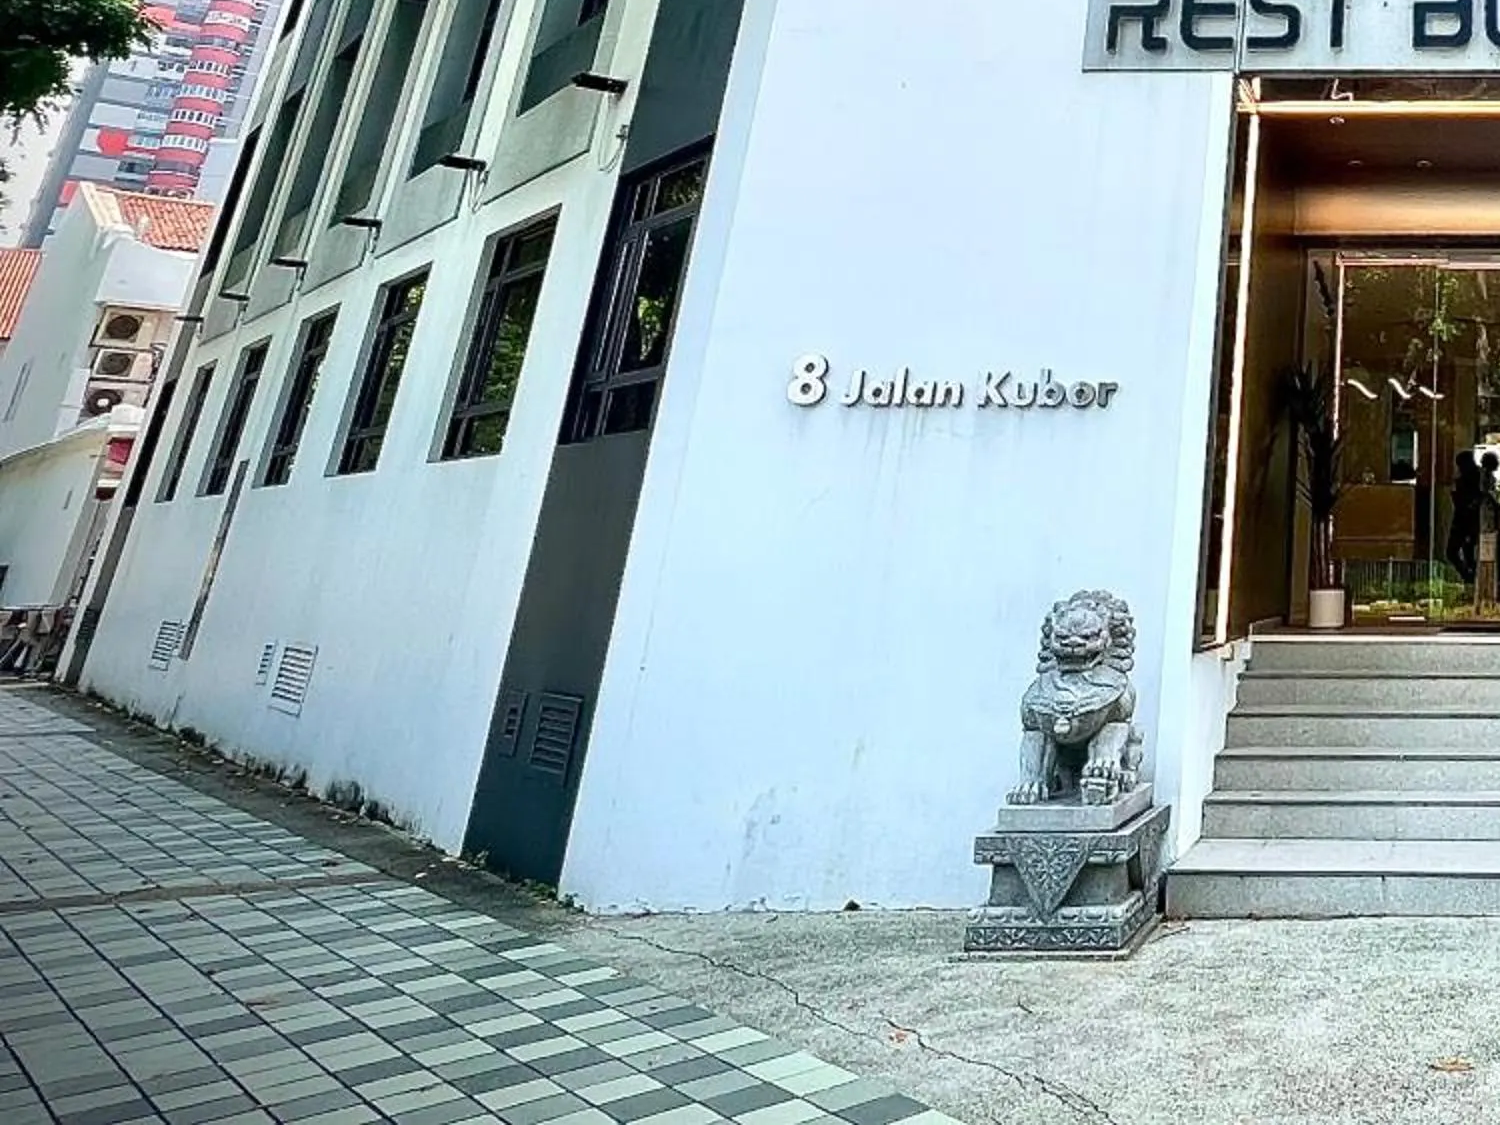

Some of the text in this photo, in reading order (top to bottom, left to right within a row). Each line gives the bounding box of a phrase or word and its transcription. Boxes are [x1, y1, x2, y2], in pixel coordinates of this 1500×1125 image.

[787, 354, 1118, 410] 8 Jalan Kubor
